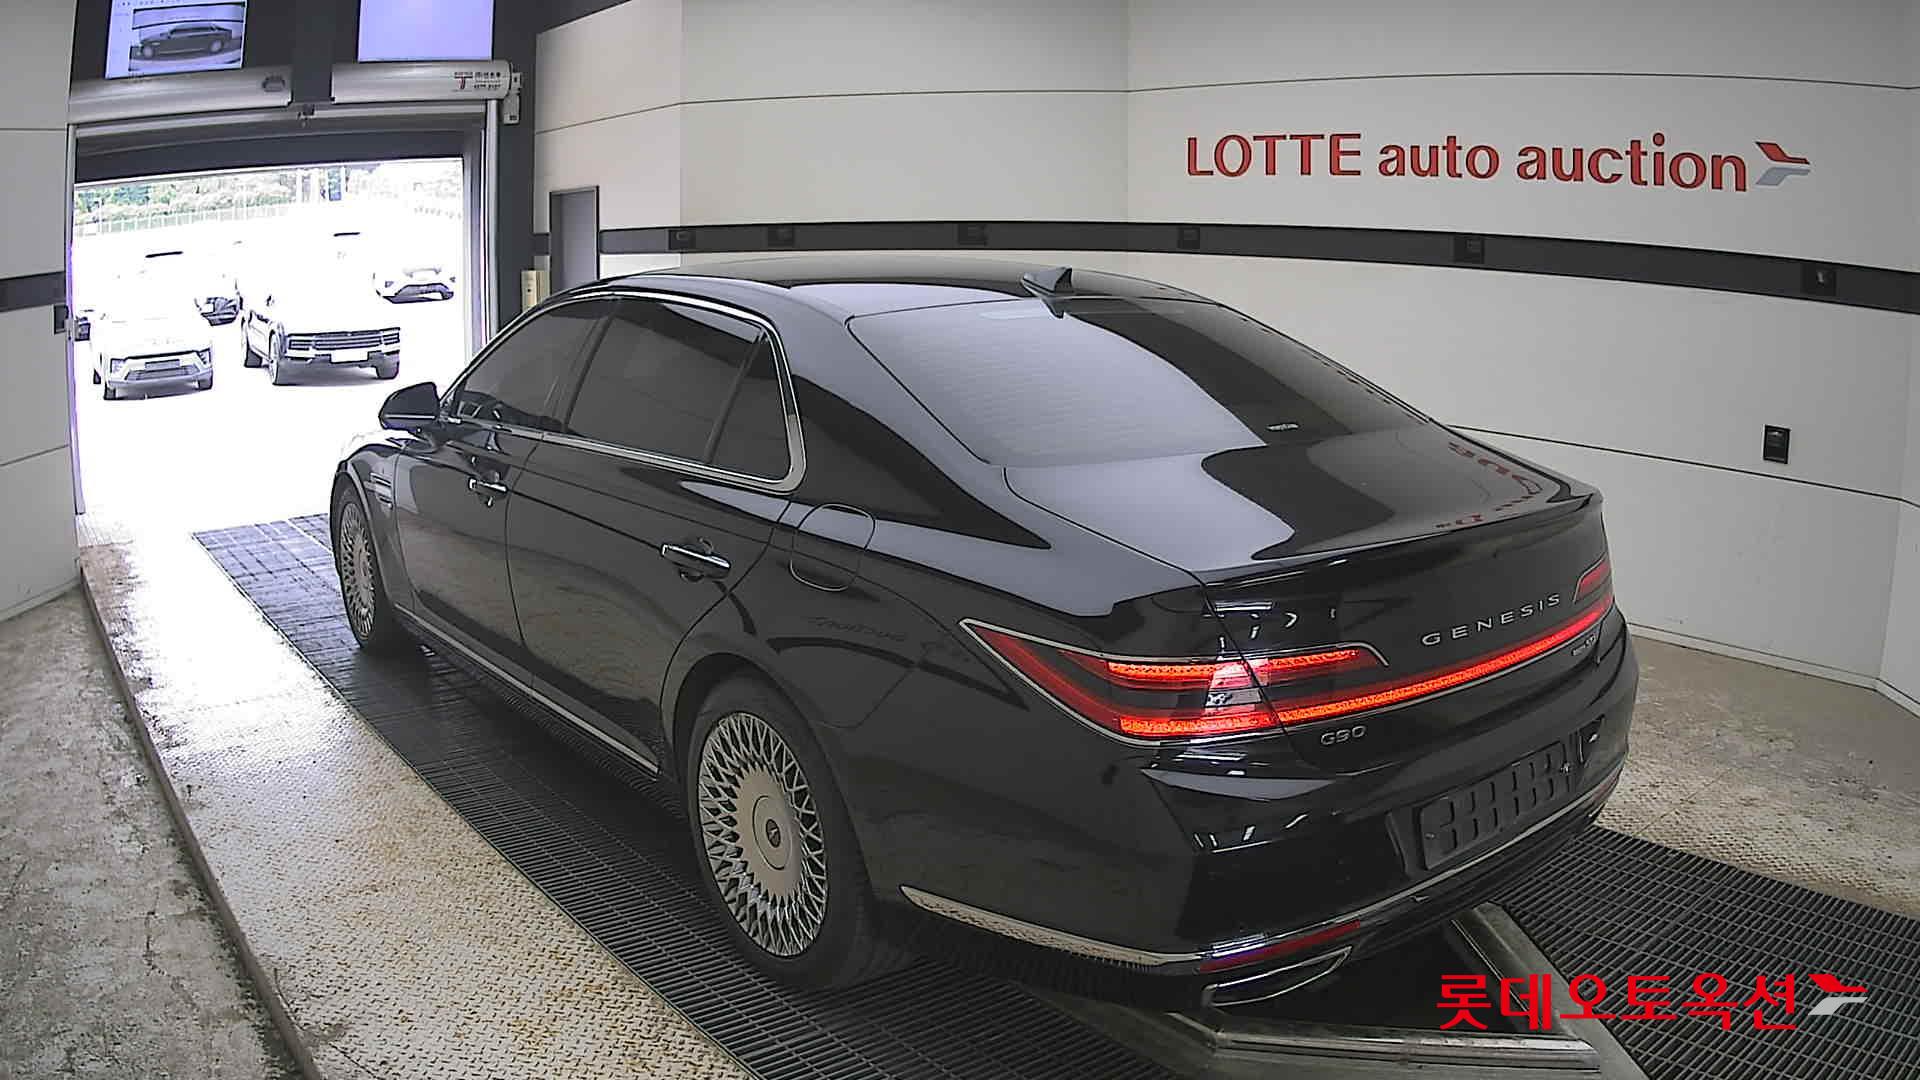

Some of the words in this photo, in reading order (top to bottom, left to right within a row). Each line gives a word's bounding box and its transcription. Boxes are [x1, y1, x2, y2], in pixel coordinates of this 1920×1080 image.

[1187, 133, 1361, 177] LOTTE
[1378, 137, 1501, 179] auto
[1518, 134, 1748, 192] auction
[1421, 593, 1561, 647] GENESIS
[1320, 725, 1366, 746] G90
